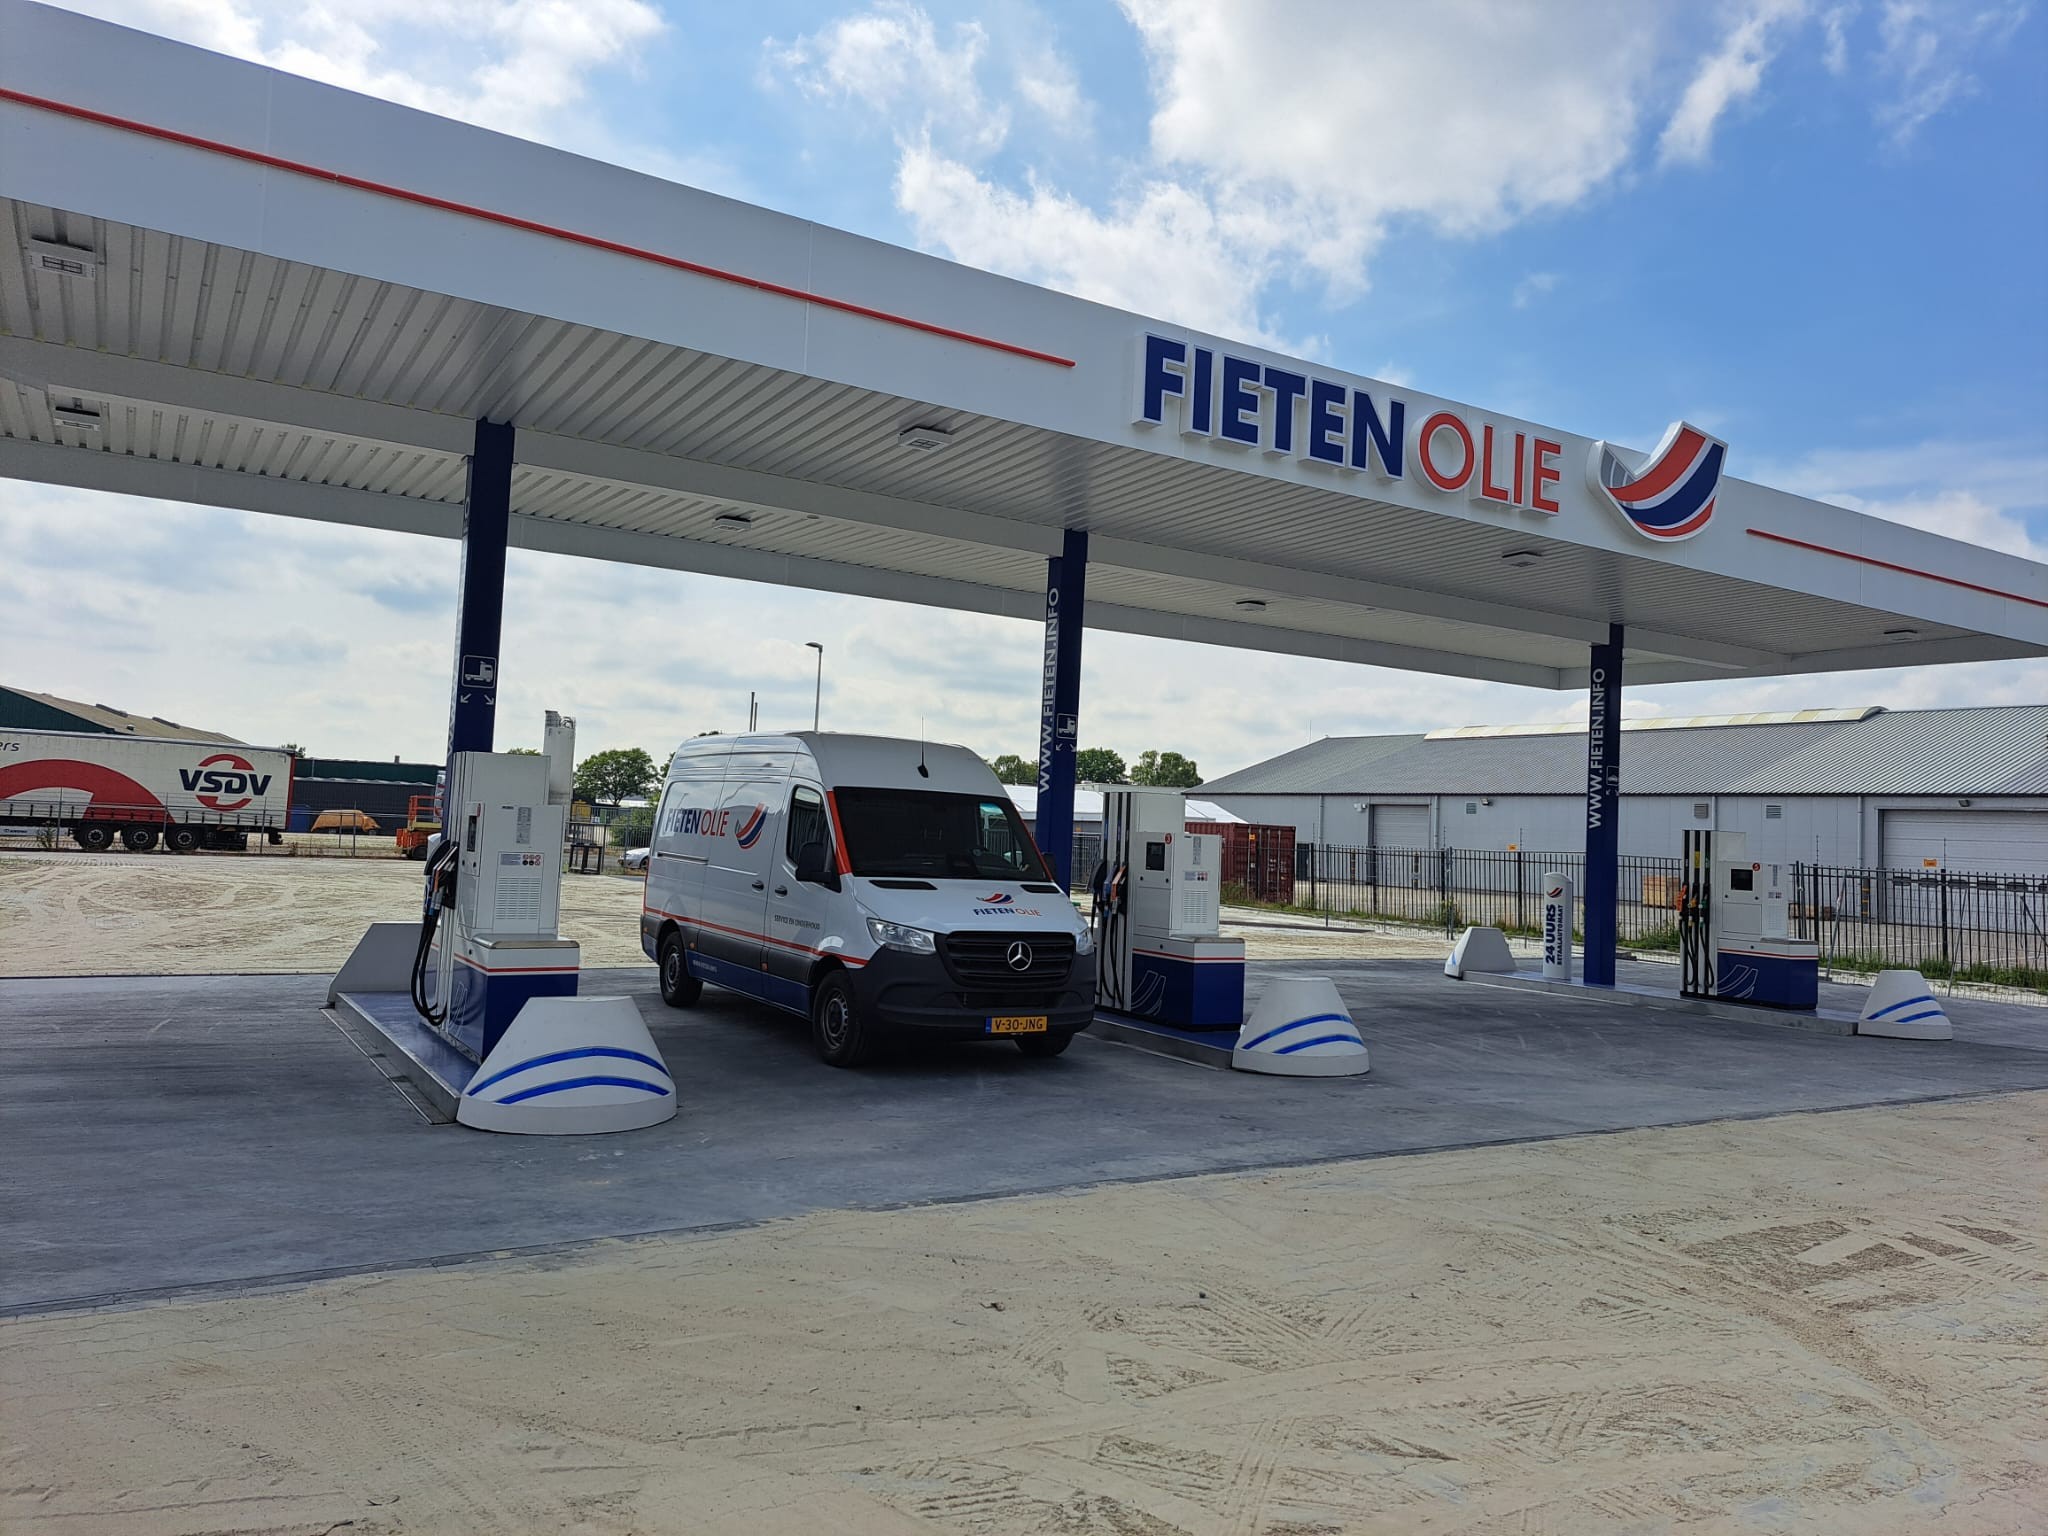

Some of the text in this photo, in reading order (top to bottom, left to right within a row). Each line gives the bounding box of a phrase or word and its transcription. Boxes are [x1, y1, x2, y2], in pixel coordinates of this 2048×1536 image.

[1039, 587, 1059, 794] WWW.FIETEN.INFO
[1588, 668, 1606, 830] WWW.FIETEN.INFO
[179, 768, 272, 796] VSDV
[1545, 903, 1556, 965] 24 UURS
[994, 1018, 1043, 1031] V-30-JNG
